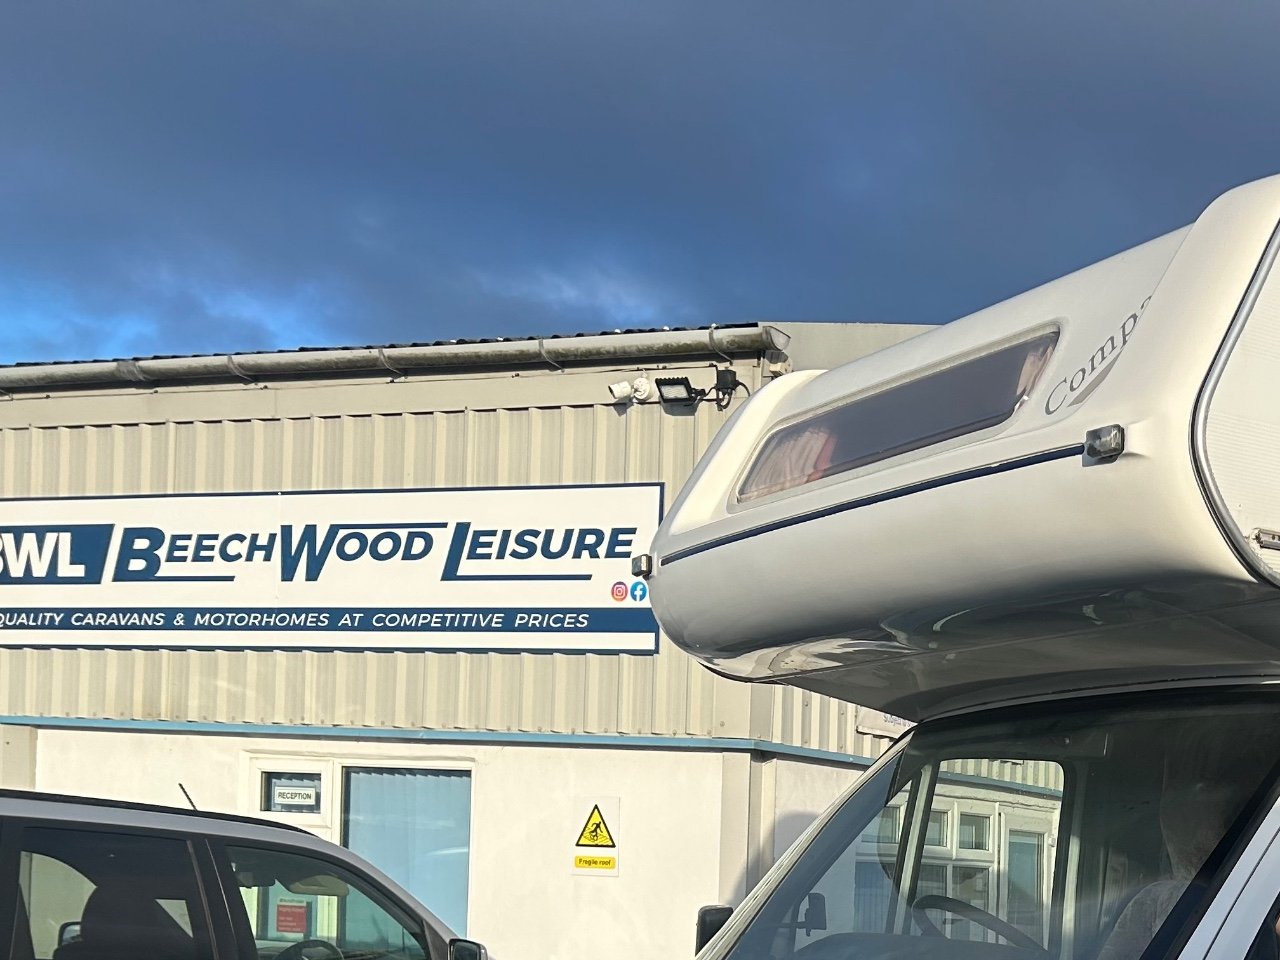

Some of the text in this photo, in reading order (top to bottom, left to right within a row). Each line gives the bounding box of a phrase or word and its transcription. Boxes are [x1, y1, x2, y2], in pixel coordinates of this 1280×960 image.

[0, 532, 86, 578] WL
[441, 521, 637, 582] LEISURE
[71, 612, 165, 626] CARAVANS
[173, 612, 186, 626] &
[194, 612, 330, 627] MOTORHOMES
[338, 613, 364, 627] AT
[372, 613, 504, 628] COMPETITIVE
[515, 613, 589, 628] PRICES
[277, 791, 312, 800] RECEPTION
